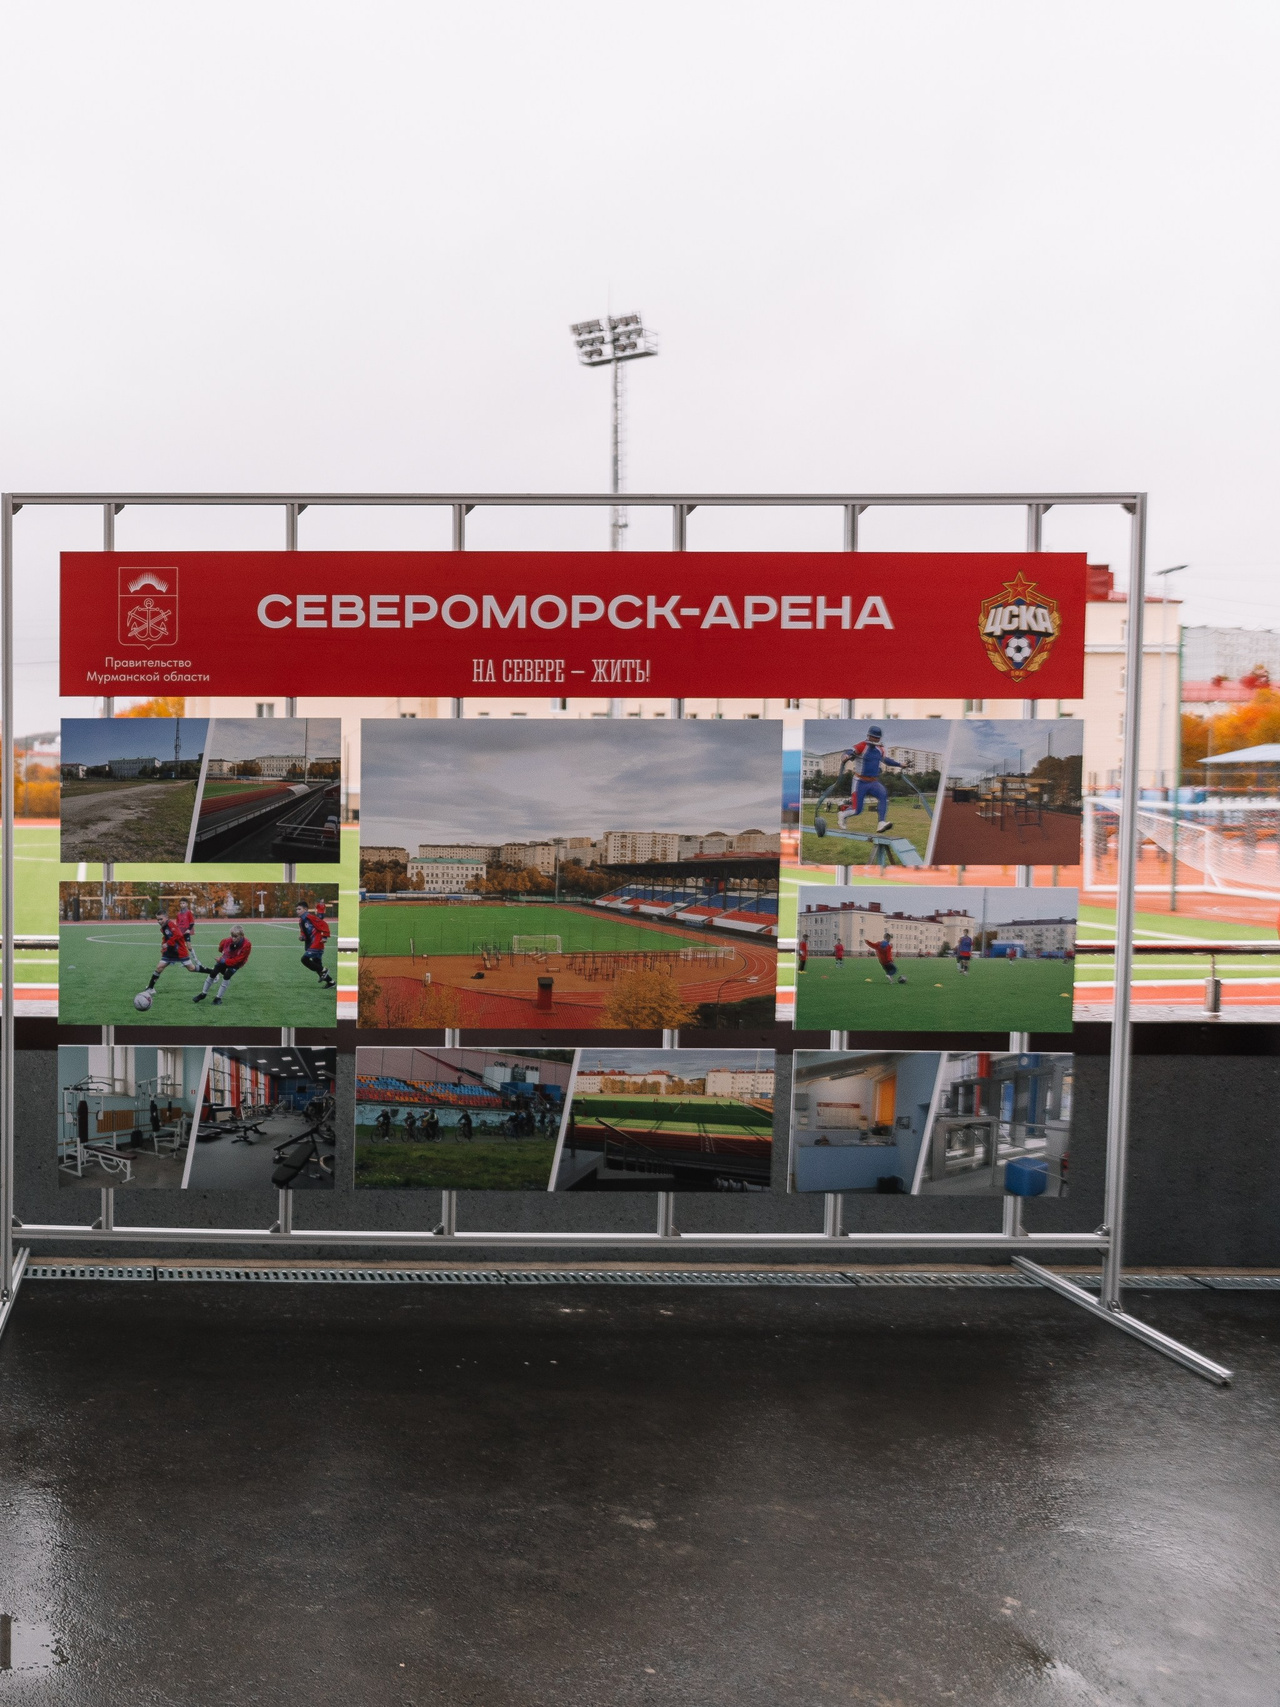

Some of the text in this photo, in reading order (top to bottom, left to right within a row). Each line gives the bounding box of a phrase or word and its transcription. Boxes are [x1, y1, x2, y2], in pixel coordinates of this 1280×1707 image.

[256, 594, 894, 630] СЕВЕРОМОРСК-АРЕНА
[983, 605, 1054, 636] ЦСКА
[105, 656, 192, 670] Правительство
[472, 659, 497, 682] НА
[502, 659, 565, 683] СЕВЕРЕ
[591, 659, 651, 683] ЖИТЬ!
[86, 671, 210, 685] Мурманской области
